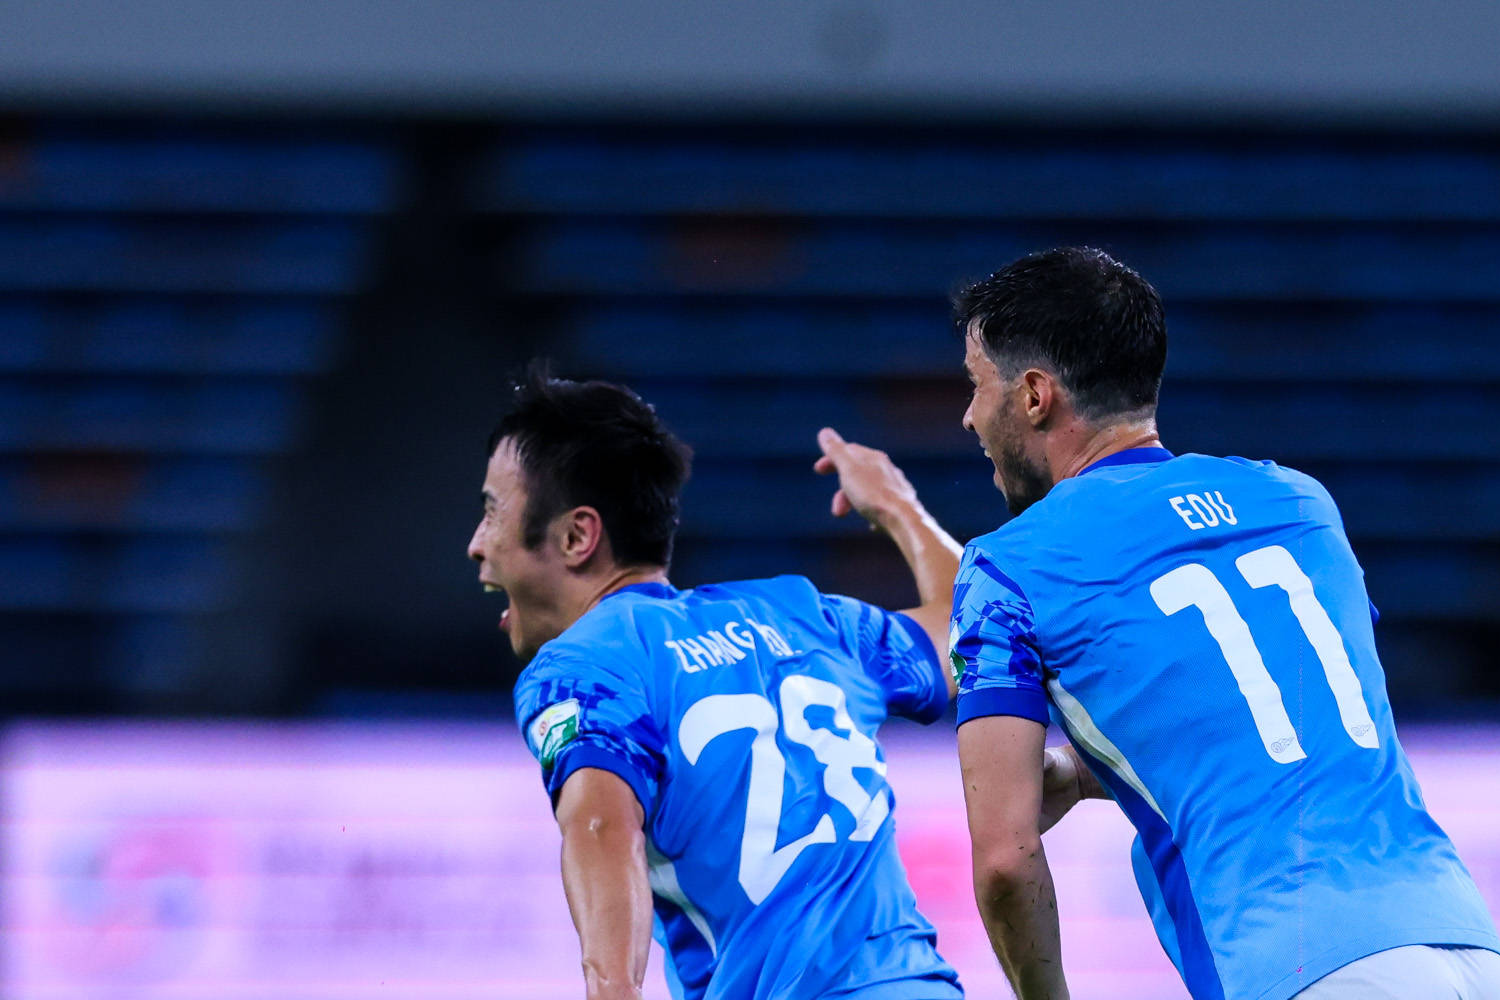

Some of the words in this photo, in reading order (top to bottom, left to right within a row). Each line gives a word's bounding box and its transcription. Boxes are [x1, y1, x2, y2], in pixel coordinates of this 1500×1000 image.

[1168, 490, 1238, 530] EDU
[664, 621, 756, 673] ZHANG
[1150, 545, 1380, 764] 11
[678, 674, 888, 907] 28
